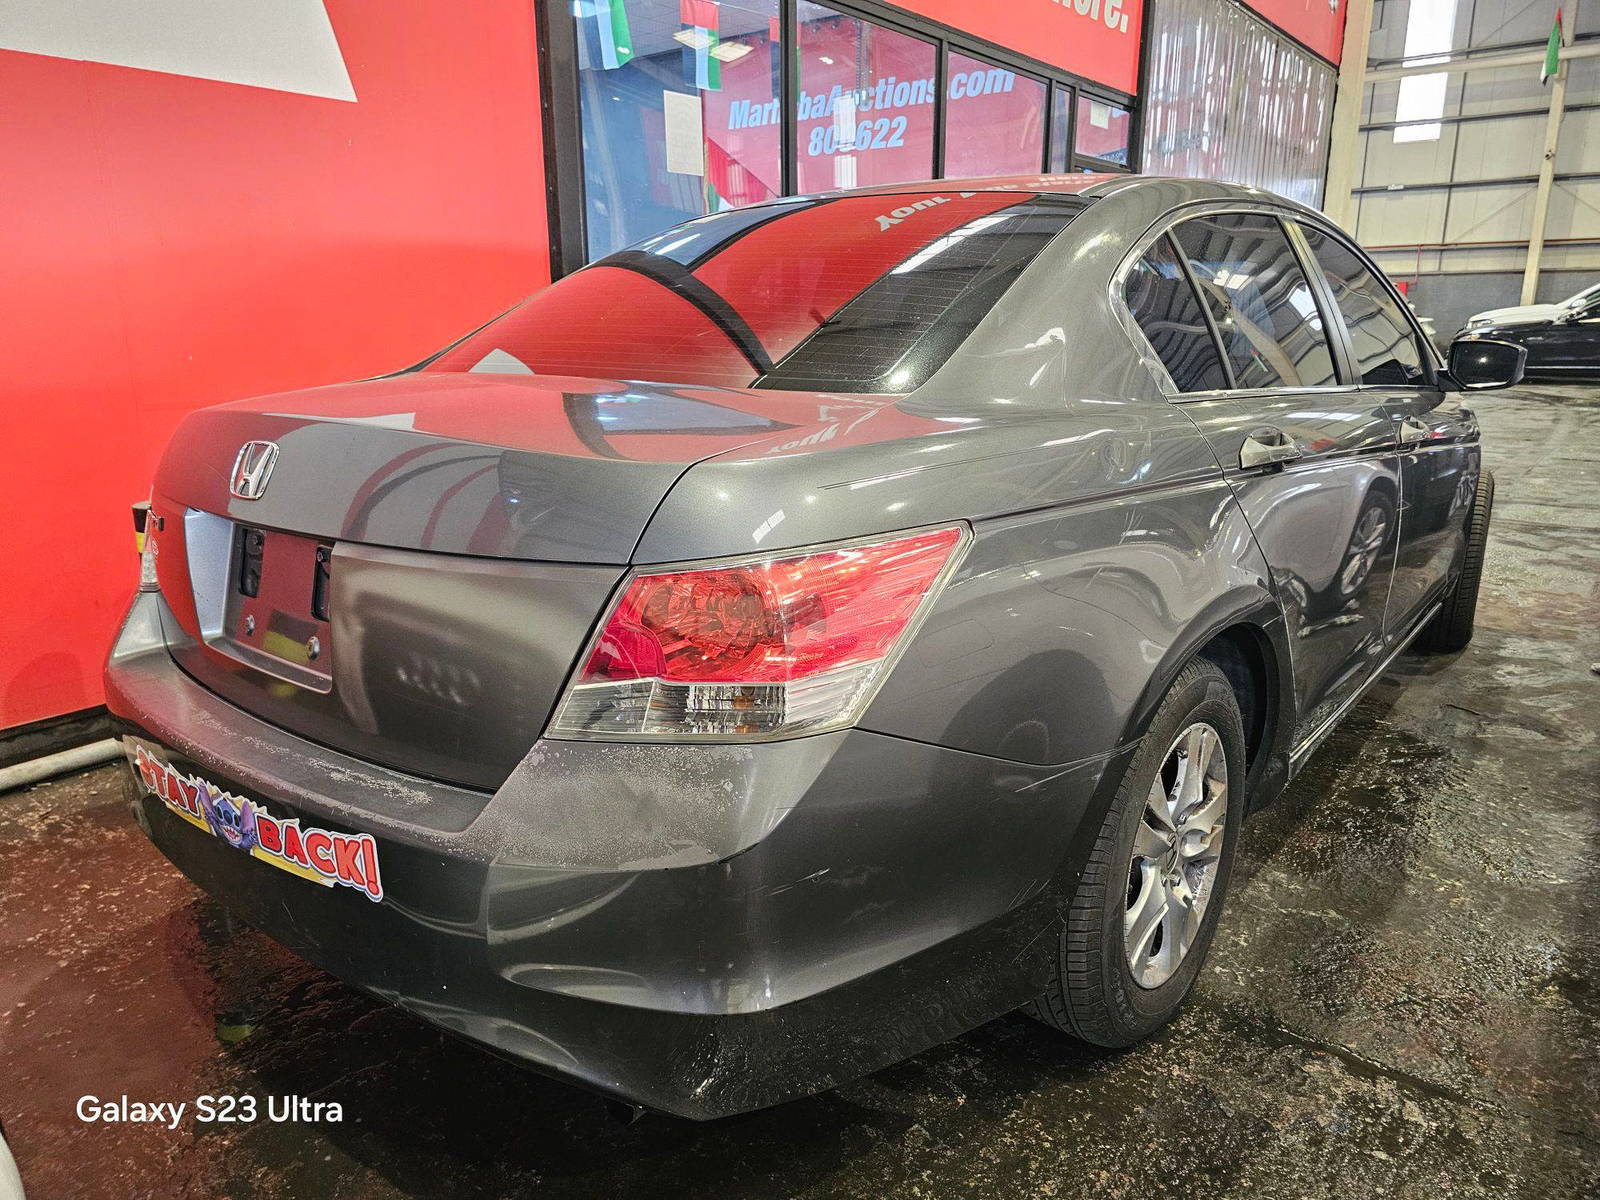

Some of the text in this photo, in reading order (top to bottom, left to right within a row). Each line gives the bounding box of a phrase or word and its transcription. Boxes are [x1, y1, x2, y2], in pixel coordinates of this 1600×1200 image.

[808, 116, 907, 156] 80622
[136, 746, 381, 898] STAY BACK!
